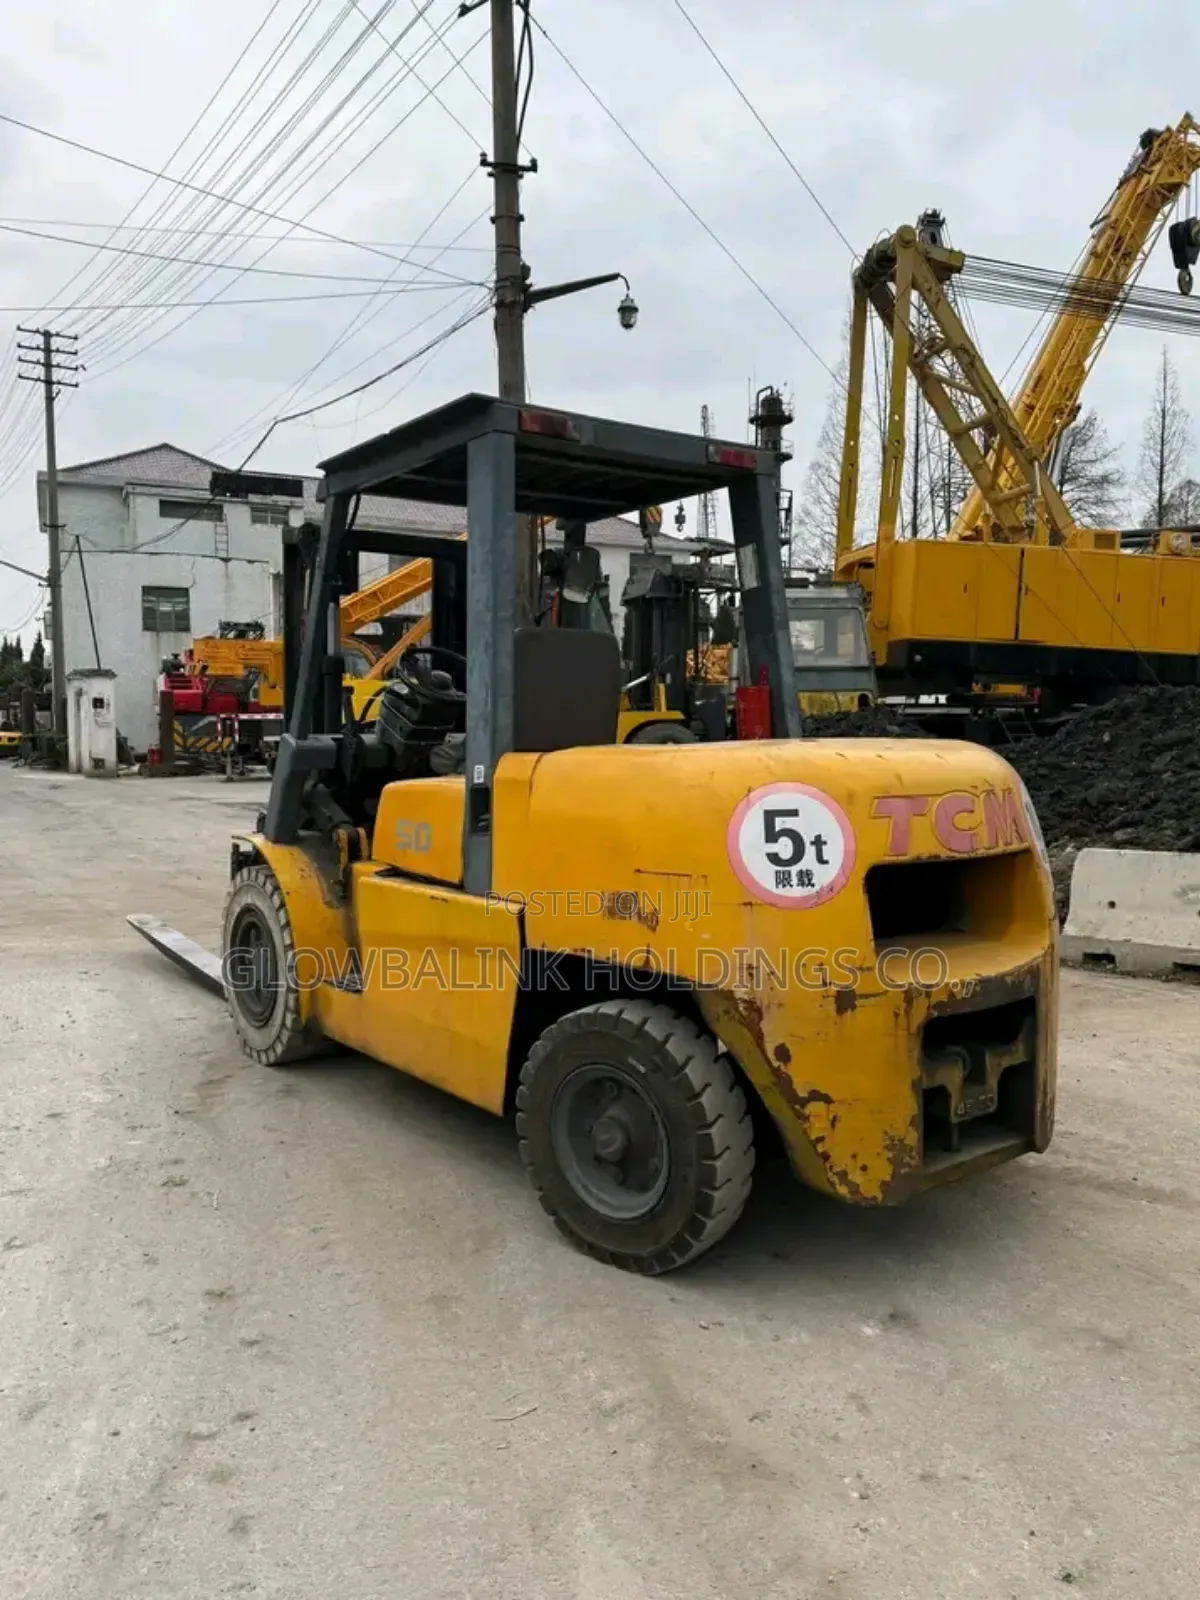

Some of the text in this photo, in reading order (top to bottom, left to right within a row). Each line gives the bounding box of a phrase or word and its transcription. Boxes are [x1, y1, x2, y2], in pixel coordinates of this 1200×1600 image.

[763, 809, 830, 868] 5t
[873, 790, 1028, 855] TCM
[774, 869, 815, 889] 限载
